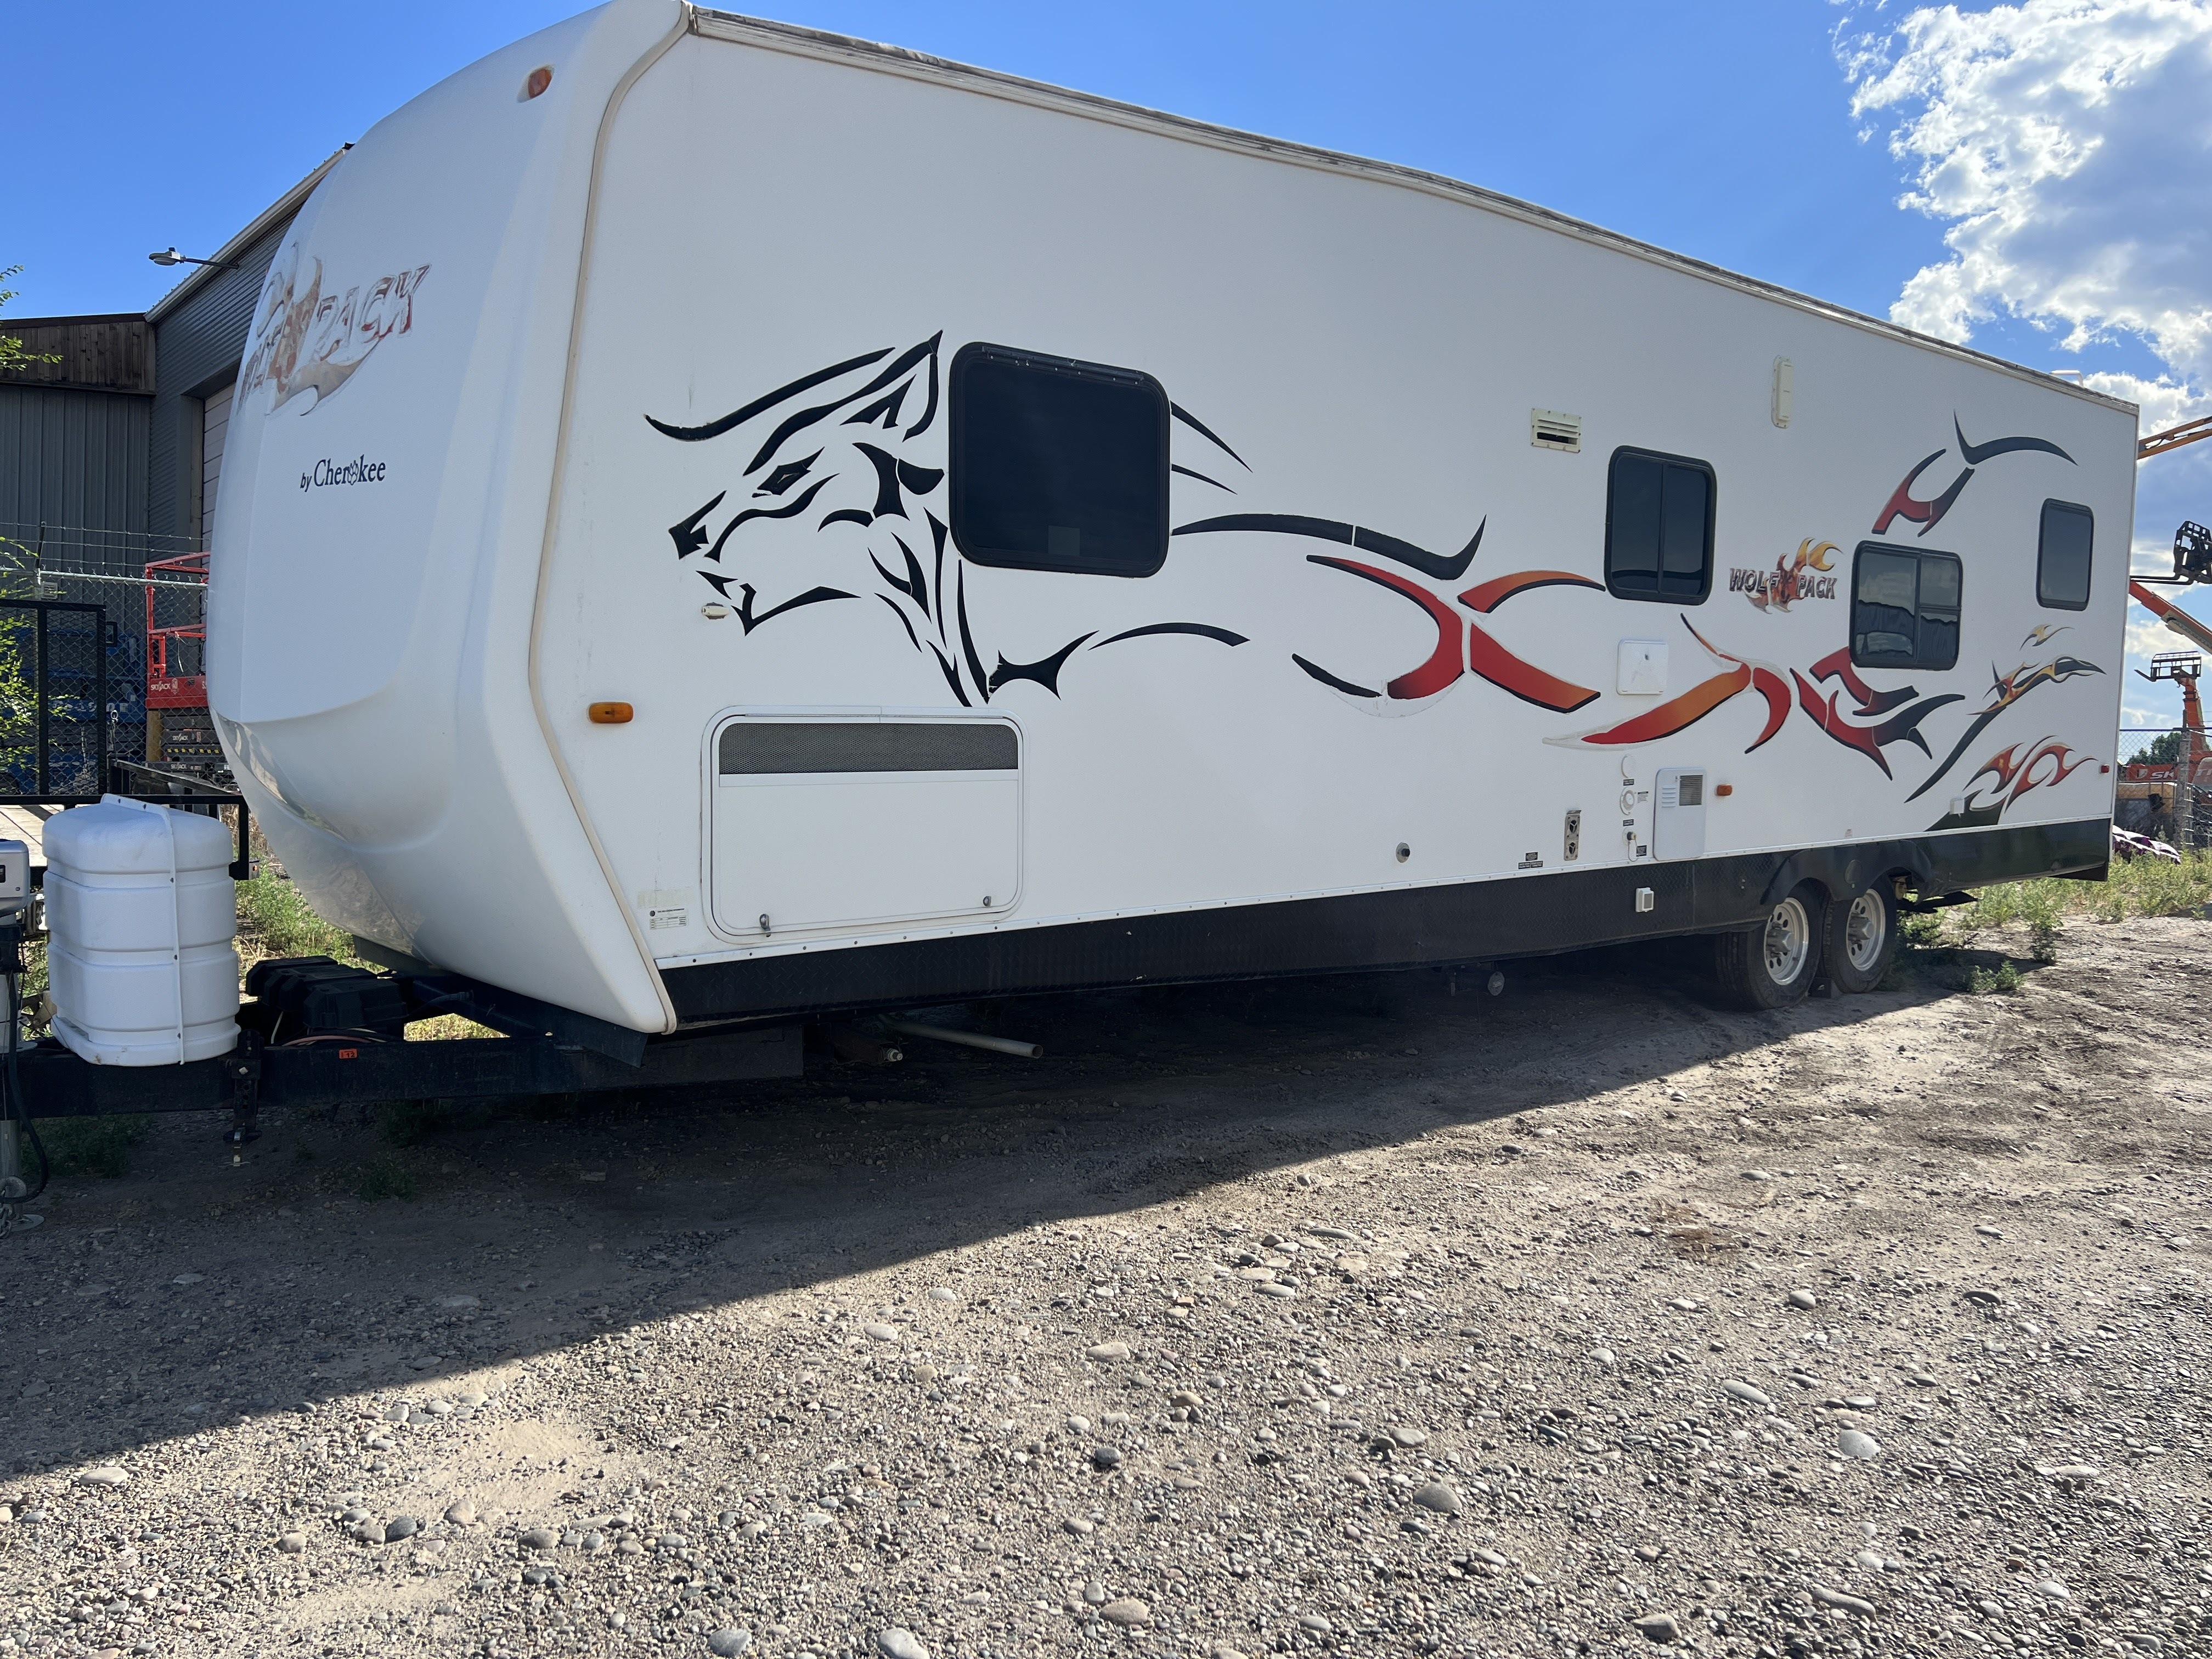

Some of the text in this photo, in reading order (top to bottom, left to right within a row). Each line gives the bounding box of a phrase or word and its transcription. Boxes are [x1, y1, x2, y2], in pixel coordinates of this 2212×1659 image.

[300, 472, 312, 492] by
[1730, 567, 1837, 600] WOLF PACK
